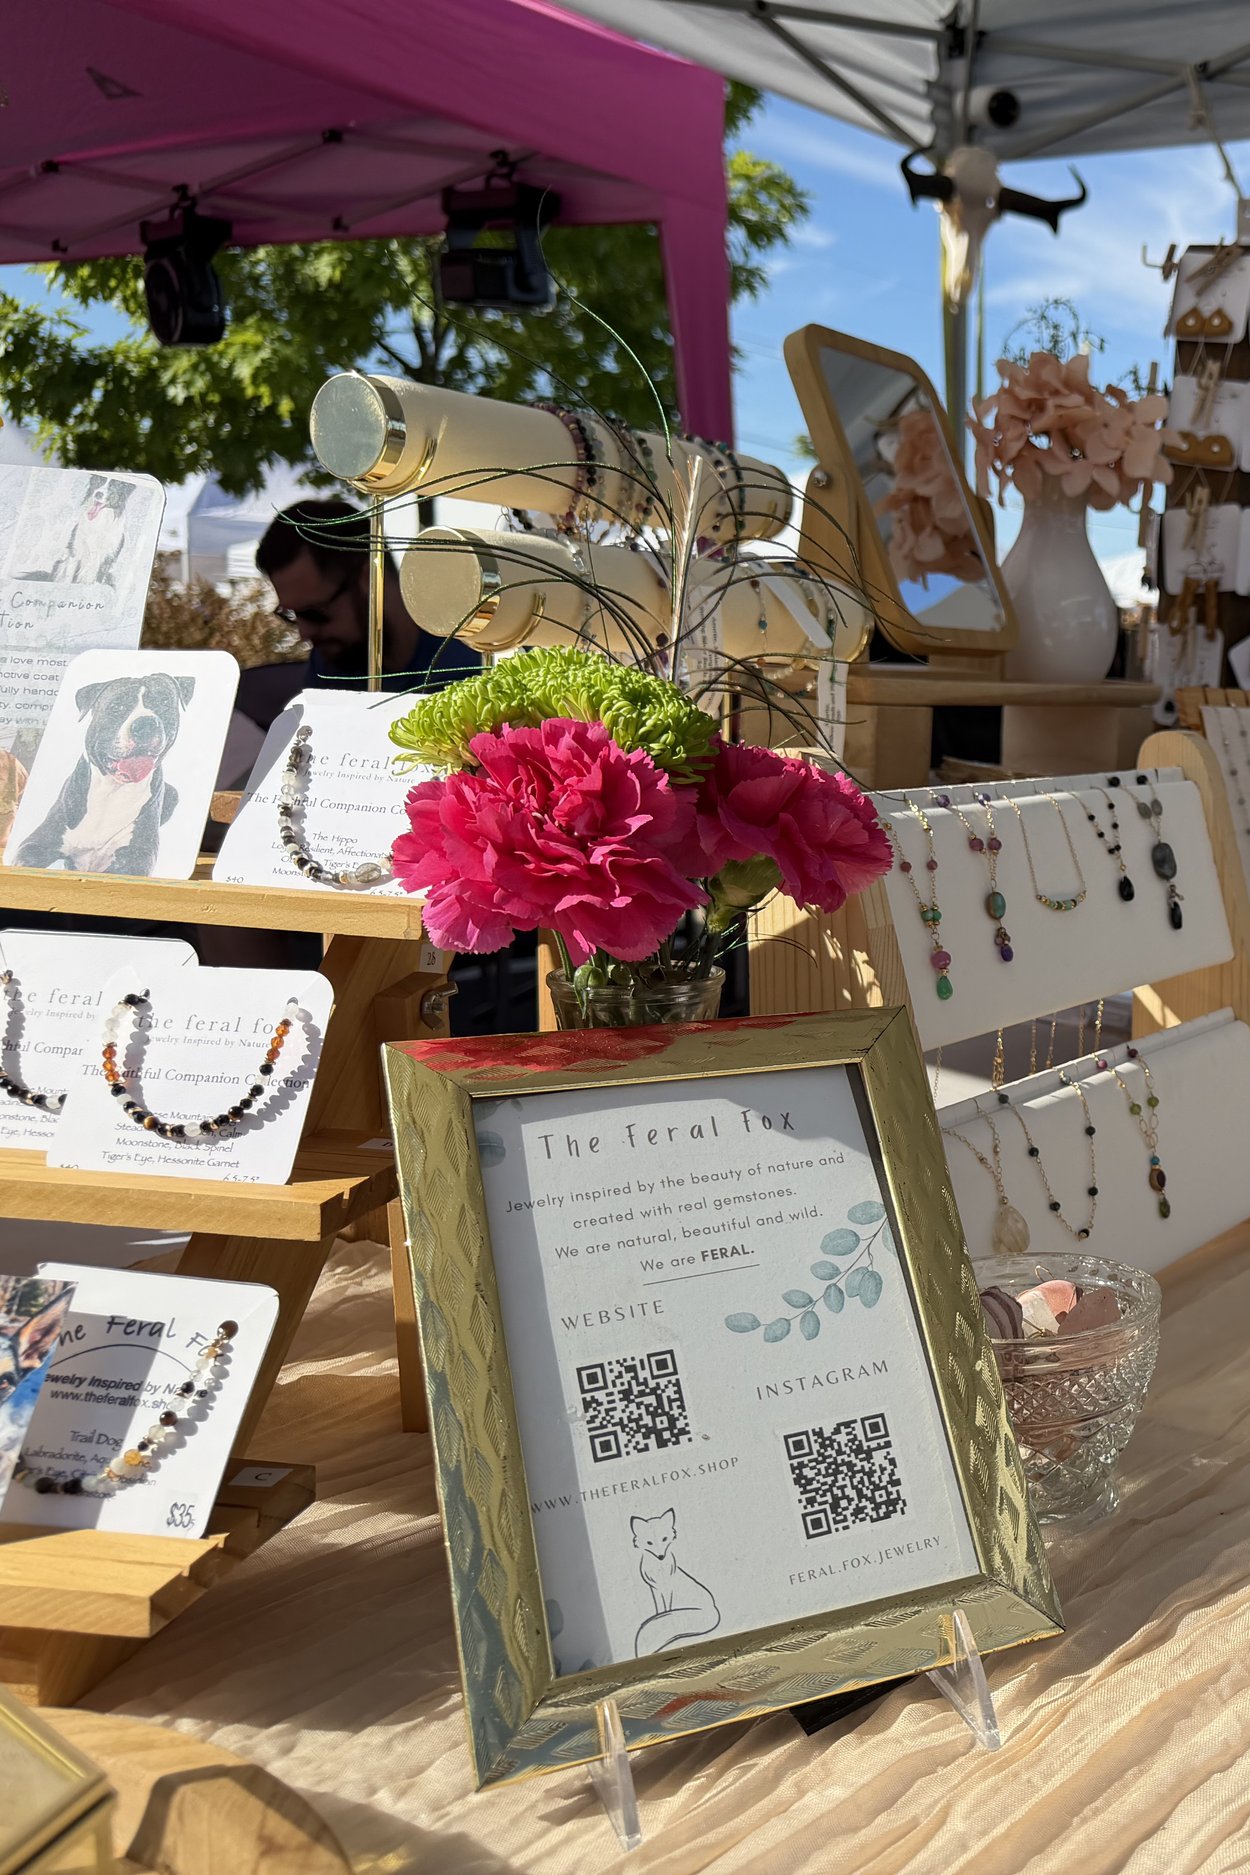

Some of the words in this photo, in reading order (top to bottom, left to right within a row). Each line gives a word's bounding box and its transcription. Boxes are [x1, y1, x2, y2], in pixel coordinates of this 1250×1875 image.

[10, 591, 104, 618] Companion
[10, 656, 33, 665] love
[340, 753, 389, 770] feral
[337, 771, 372, 783] Inspired
[374, 773, 384, 783] by
[247, 792, 269, 804] The
[271, 793, 317, 808] Fhful
[319, 799, 387, 815] Companion
[312, 832, 329, 842] The
[331, 833, 358, 846] Hippo
[48, 988, 103, 1007] feral
[46, 1009, 83, 1020] Inspired
[138, 1013, 173, 1029] the
[185, 1014, 242, 1033] feral
[253, 1018, 274, 1035] fo
[183, 1037, 221, 1047] Inspired
[224, 1038, 234, 1048] by
[166, 1070, 240, 1087] Companion
[244, 1073, 310, 1089] Clection
[537, 1133, 600, 1160] The
[625, 1114, 719, 1150] Feral
[740, 1108, 796, 1134] Fox
[116, 1137, 172, 1150] Moonstone,
[175, 1139, 200, 1151] Black
[204, 1142, 234, 1156] Spinel
[101, 1151, 132, 1164] Tiger's
[134, 1153, 155, 1165] Eye,
[157, 1155, 206, 1167] Hessonite
[207, 1158, 240, 1169] Garnet
[505, 1194, 565, 1214] Jewelry
[569, 1181, 632, 1205] inspired
[637, 1179, 656, 1196] by
[660, 1174, 686, 1189] the
[690, 1165, 743, 1186] beauty
[747, 1162, 763, 1177] of
[767, 1157, 815, 1175] nature
[818, 1151, 846, 1167] and
[572, 1207, 635, 1230] created
[639, 1202, 673, 1219] with
[677, 1198, 708, 1214] real
[713, 1187, 797, 1211] gemstones.
[554, 1244, 580, 1260] We
[585, 1241, 612, 1255] are
[616, 1226, 677, 1251] natural,
[681, 1215, 752, 1240] beautiful
[755, 1212, 785, 1228] and
[788, 1204, 824, 1223] wild.
[640, 1257, 666, 1273] We
[669, 1254, 696, 1268] are
[700, 1243, 756, 1263] FERAL.
[561, 1299, 666, 1331] WEBSITE
[105, 1314, 177, 1340] Feral
[88, 1375, 144, 1393] Inspired
[144, 1383, 161, 1396] by
[163, 1384, 208, 1399] Nare
[755, 1359, 890, 1401] INSTAGRAM
[50, 1388, 171, 1411] www.theferalfox.sh
[70, 1428, 94, 1444] Trail
[96, 1433, 124, 1451] Dog
[255, 1472, 273, 1482] C
[530, 1455, 740, 1515] WWW.THEFERALFOX.SHOP
[788, 1535, 942, 1585] FERAL.FOX.JEWELRY
